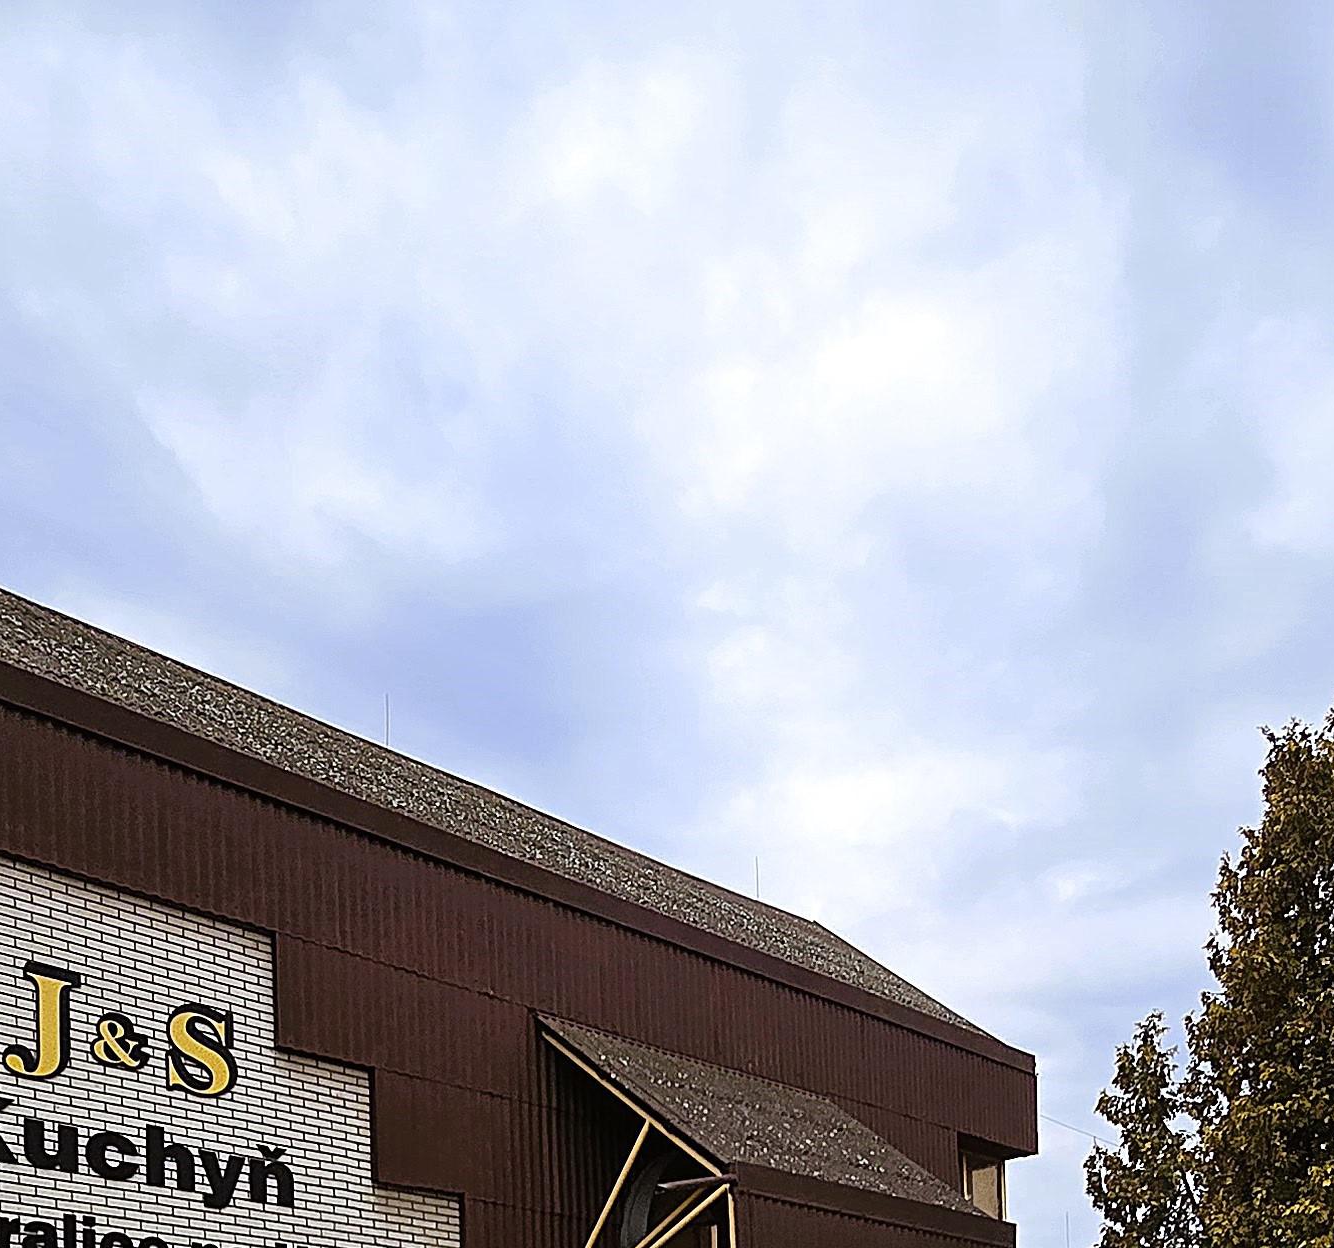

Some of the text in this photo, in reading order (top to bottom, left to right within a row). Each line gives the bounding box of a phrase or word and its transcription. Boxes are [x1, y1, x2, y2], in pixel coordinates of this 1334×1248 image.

[2, 961, 238, 1097] J & S
